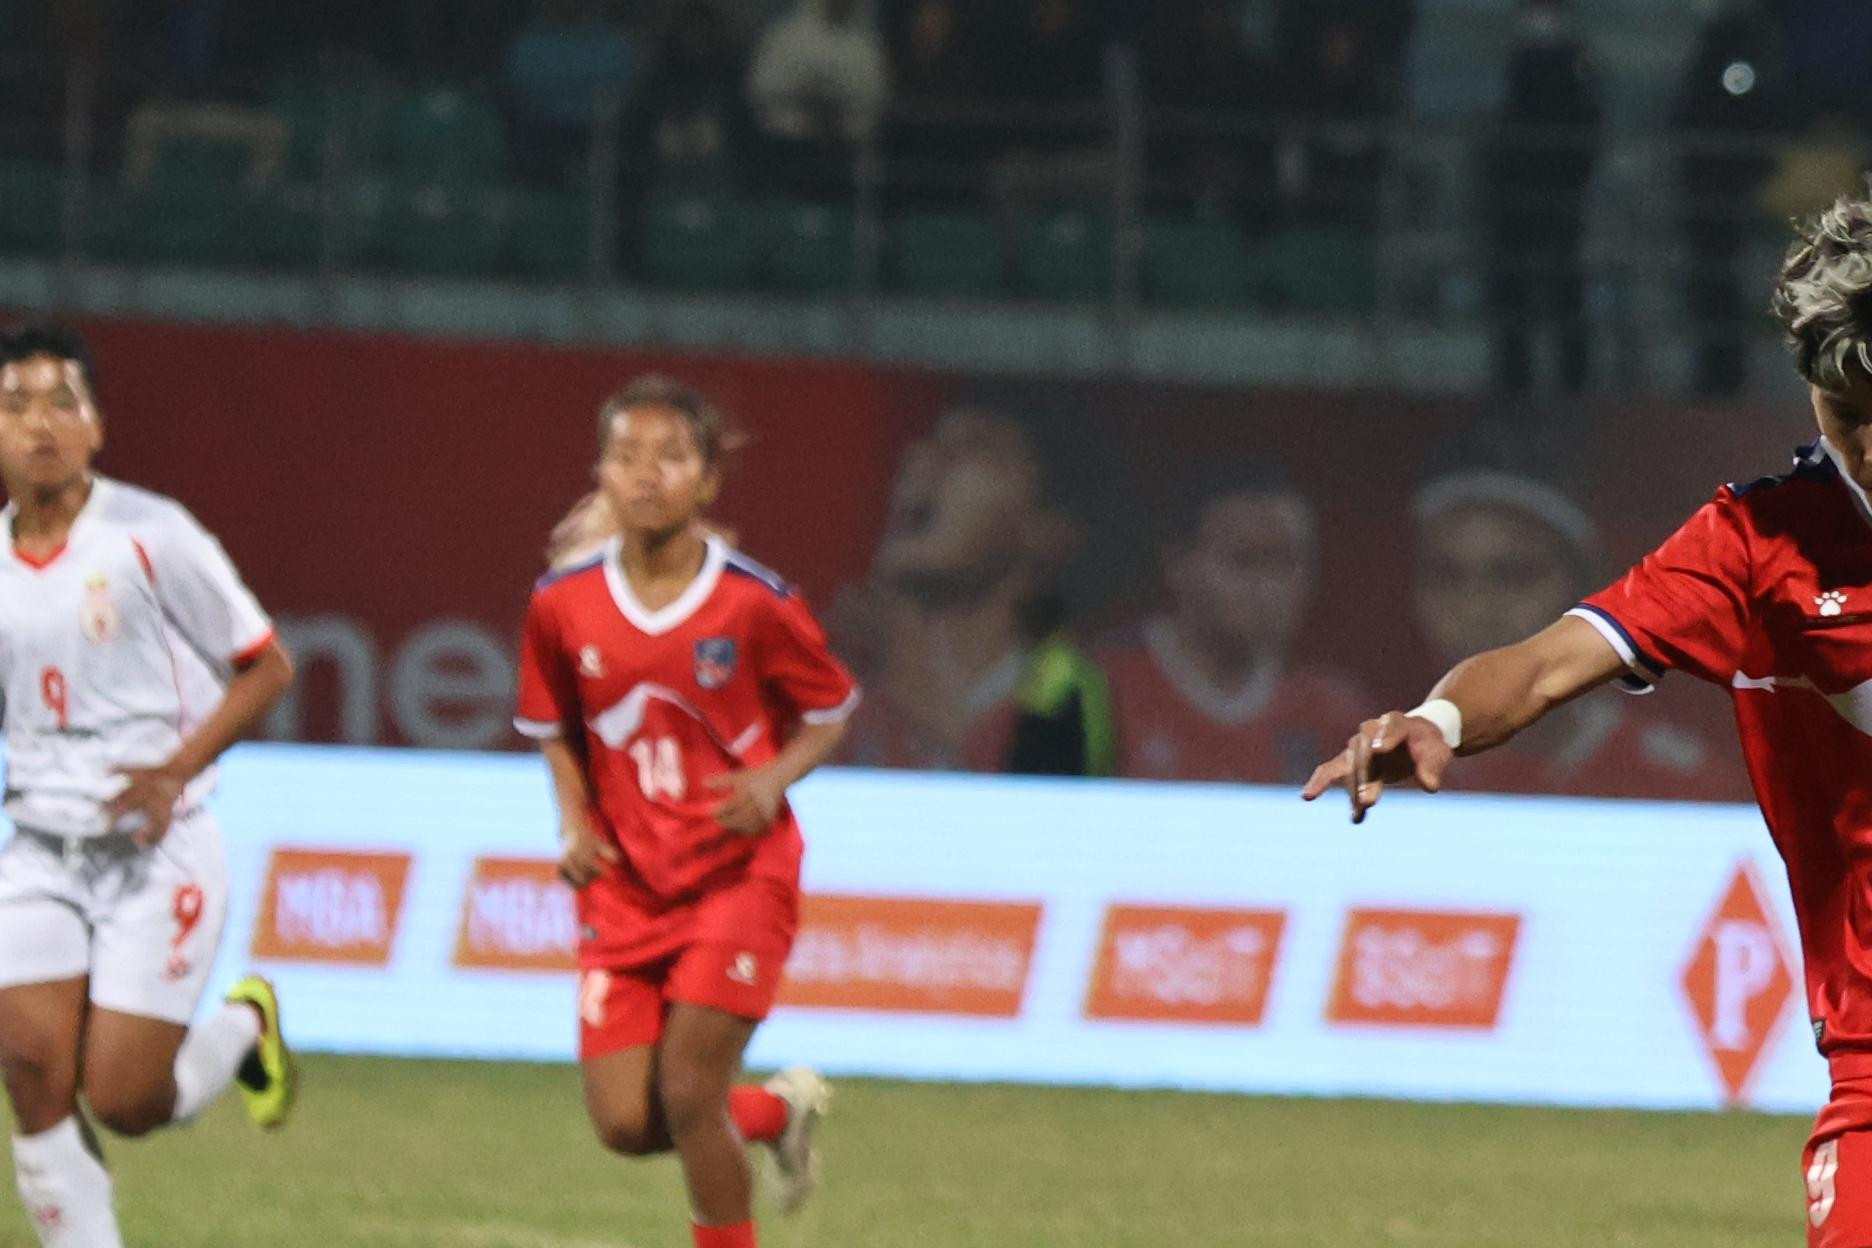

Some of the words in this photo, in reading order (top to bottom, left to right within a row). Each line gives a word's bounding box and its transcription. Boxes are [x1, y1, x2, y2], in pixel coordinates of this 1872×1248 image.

[41, 664, 69, 731] 9
[629, 735, 686, 801] 14
[170, 883, 206, 948] 9
[1714, 918, 1777, 1051] P
